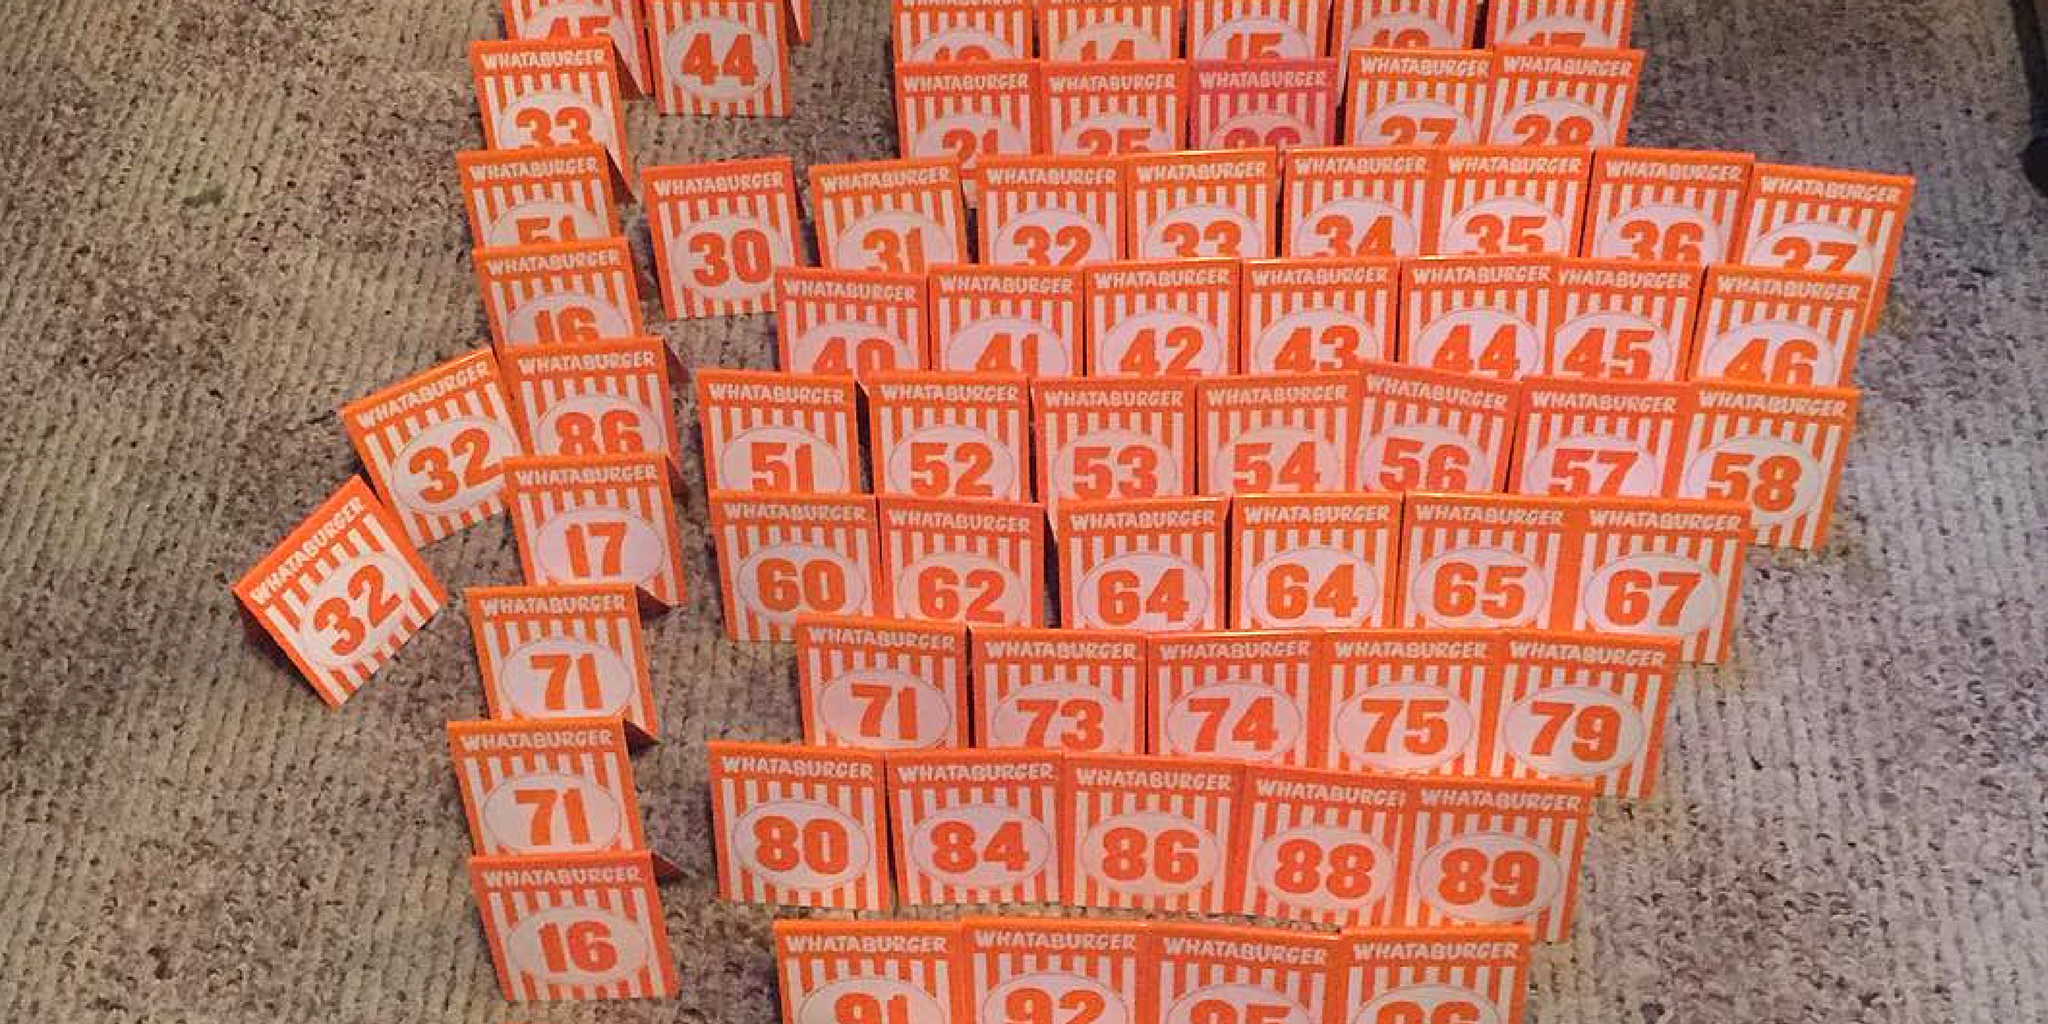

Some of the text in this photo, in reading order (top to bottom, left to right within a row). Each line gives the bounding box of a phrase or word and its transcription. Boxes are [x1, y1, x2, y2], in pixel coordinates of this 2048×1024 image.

[480, 49, 604, 69] WHATABURGER
[681, 33, 758, 86] 44
[1361, 56, 1491, 76] WHATABURGER
[1504, 56, 1633, 77] WHATABURGER
[904, 73, 1029, 91] WHATABURGER
[1050, 73, 1176, 91] WHATABURGER
[1199, 71, 1325, 88] WHATABURGER
[516, 107, 592, 147] 33
[470, 156, 597, 182] WHATABURGER
[987, 168, 1116, 185] WHATABURGER
[1137, 162, 1267, 183] WHATABURGER
[1294, 155, 1428, 175] WHATABURGER
[1447, 155, 1583, 176] WHATABURGER
[1605, 160, 1743, 183] WHATABURGER
[654, 172, 785, 197] WHATABURGER
[821, 168, 951, 194] WHATABURGER
[1760, 175, 1901, 204] WHATABURGER
[1013, 226, 1092, 267] 32
[1314, 214, 1393, 258] 34
[1464, 215, 1546, 258] 35
[1618, 219, 1700, 261] 36
[486, 250, 619, 275] WHATABURGER
[690, 229, 772, 287] 30
[863, 228, 925, 273] 31
[940, 275, 1073, 294] WHATABURGER
[1094, 269, 1230, 289] WHATABURGER
[1248, 265, 1387, 287] WHATABURGER
[1411, 264, 1551, 284] WHATABURGER
[1717, 274, 1861, 302] WHATABURGER
[783, 279, 916, 302] WHATABURGER
[518, 352, 656, 374] WHATABURGER
[813, 337, 894, 374] 40
[975, 332, 1038, 374] 41
[1119, 325, 1204, 376] 42
[1275, 324, 1357, 374] 43
[1431, 324, 1521, 374] 44
[1563, 327, 1655, 380] 45
[1724, 338, 1816, 382] 46
[355, 361, 490, 428] WHATABURGER
[708, 383, 844, 404] WHATABURGER
[881, 384, 1019, 402] WHATABURGER
[1044, 390, 1183, 407] WHATABURGER
[1207, 384, 1348, 407] WHATABURGER
[1366, 374, 1508, 410] WHATABURGER
[1531, 390, 1677, 413] WHATABURGER
[1699, 390, 1849, 417] WHATABURGER
[556, 410, 643, 454] 86
[409, 428, 502, 503] 32
[516, 464, 659, 486] WHATABURGER
[752, 442, 815, 491] 51
[910, 442, 993, 498] 52
[1072, 445, 1158, 499] 53
[1232, 441, 1320, 494] 54
[1378, 437, 1470, 491] 56
[1548, 449, 1640, 497] 57
[1708, 453, 1802, 512] 58
[723, 502, 867, 522] WHATABURGER
[888, 508, 1031, 533] WHATABURGER
[1070, 508, 1216, 530] WHATABURGER
[1244, 505, 1389, 523] WHATABURGER
[1415, 505, 1565, 526] WHATABURGER
[1588, 509, 1741, 531] WHATABURGER
[249, 496, 366, 604] WHATABURGER
[565, 522, 627, 578] 17
[756, 559, 846, 612] 60
[917, 565, 1006, 623] 62
[1100, 568, 1190, 625] 64
[1266, 563, 1358, 619] 64
[1433, 563, 1528, 618] 65
[1603, 569, 1700, 627] 67
[313, 564, 402, 657] 32
[481, 595, 626, 616] WHATABURGER
[807, 627, 956, 651] WHATABURGER
[984, 641, 1137, 660] WHATABURGER
[1160, 641, 1309, 660] WHATABURGER
[1334, 641, 1488, 661] WHATABURGER
[1509, 641, 1666, 667] WHATABURGER
[531, 654, 602, 710] 71
[851, 683, 920, 739] 71
[1187, 697, 1278, 751] 74
[1016, 699, 1104, 752] 73
[1360, 700, 1449, 755] 75
[1529, 701, 1622, 761] 79
[459, 729, 613, 751] WHATABURGER
[721, 755, 874, 780] WHATABURGER
[898, 763, 1054, 784] WHATABURGER
[1076, 767, 1231, 791] WHATABURGER
[1421, 788, 1582, 812] WHATABURGER
[515, 789, 590, 845] 71
[753, 816, 848, 875] 80
[930, 820, 1030, 874] 84
[1102, 826, 1198, 885] 86
[482, 866, 642, 887] WHATABURGER
[1274, 838, 1376, 899] 88
[1438, 847, 1540, 907] 89
[538, 920, 617, 973] 16
[785, 935, 946, 954] WHATABURGER
[974, 930, 1136, 949] WHATABURGER
[1164, 937, 1327, 965] WHATABURGER
[1353, 942, 1518, 960] WHATABURGER
[1004, 987, 1105, 1024] 92
